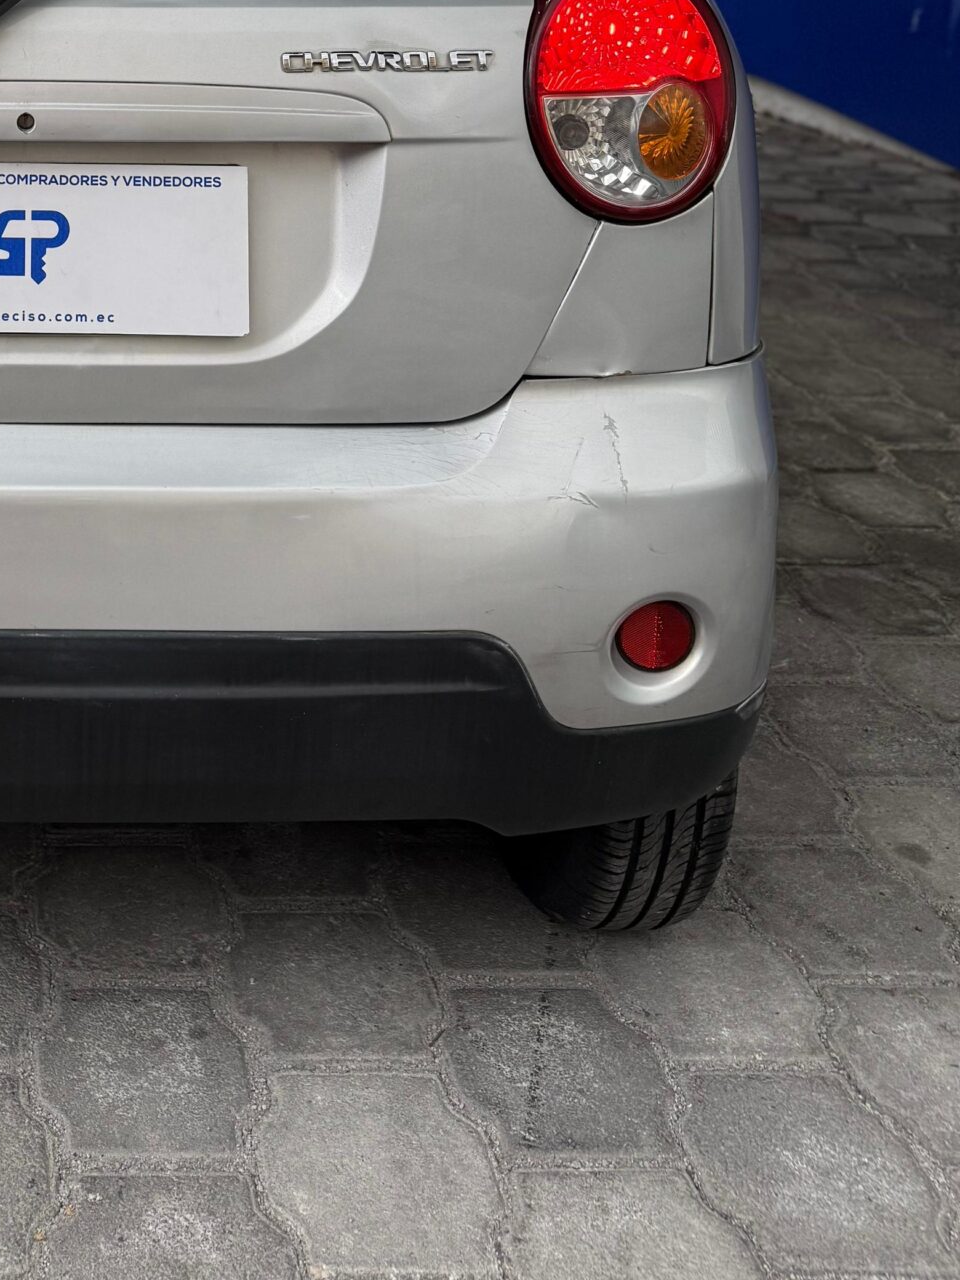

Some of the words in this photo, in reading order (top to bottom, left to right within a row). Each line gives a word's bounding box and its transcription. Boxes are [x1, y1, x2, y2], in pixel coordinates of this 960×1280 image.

[281, 50, 493, 72] CHEVROLET
[111, 175, 121, 187] Y
[123, 175, 222, 188] VENDEDORES
